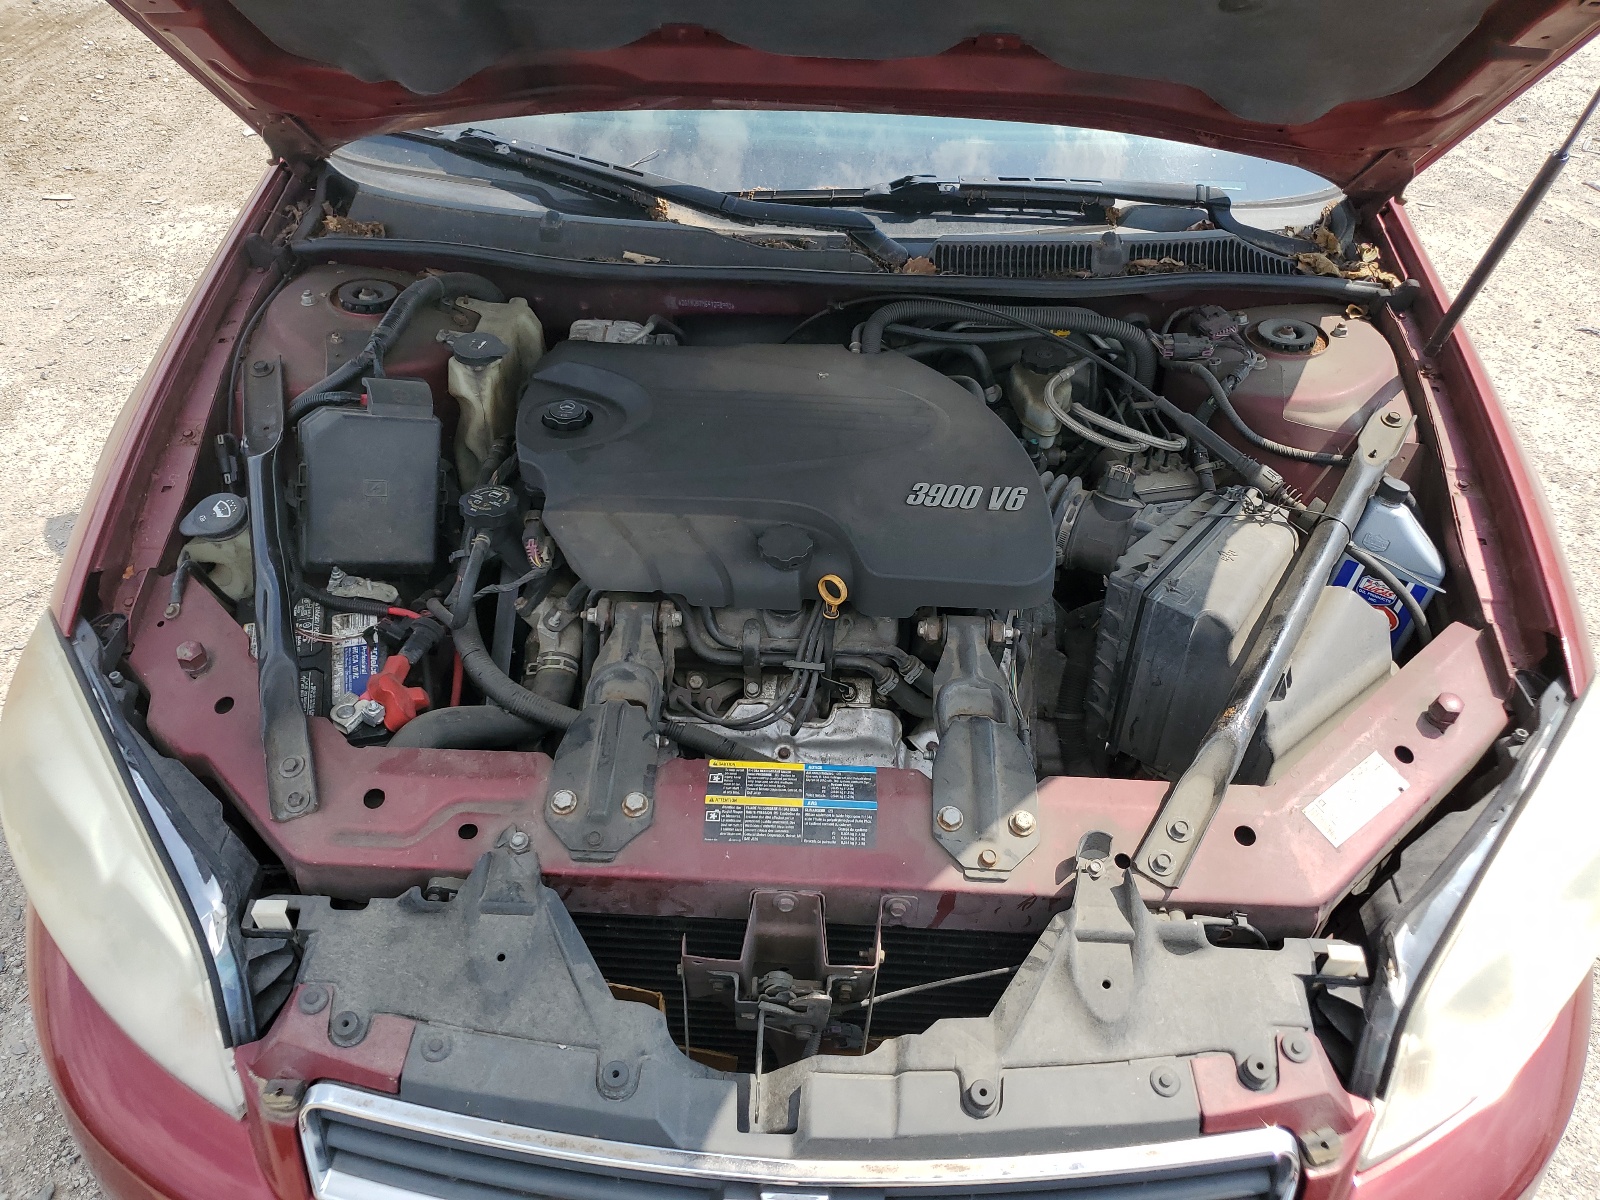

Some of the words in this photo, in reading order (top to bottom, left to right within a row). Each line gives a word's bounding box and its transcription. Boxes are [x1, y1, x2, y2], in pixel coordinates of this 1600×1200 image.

[906, 482, 984, 510] 3900
[987, 486, 1029, 511] V6
[1363, 584, 1395, 598] LUCAS
